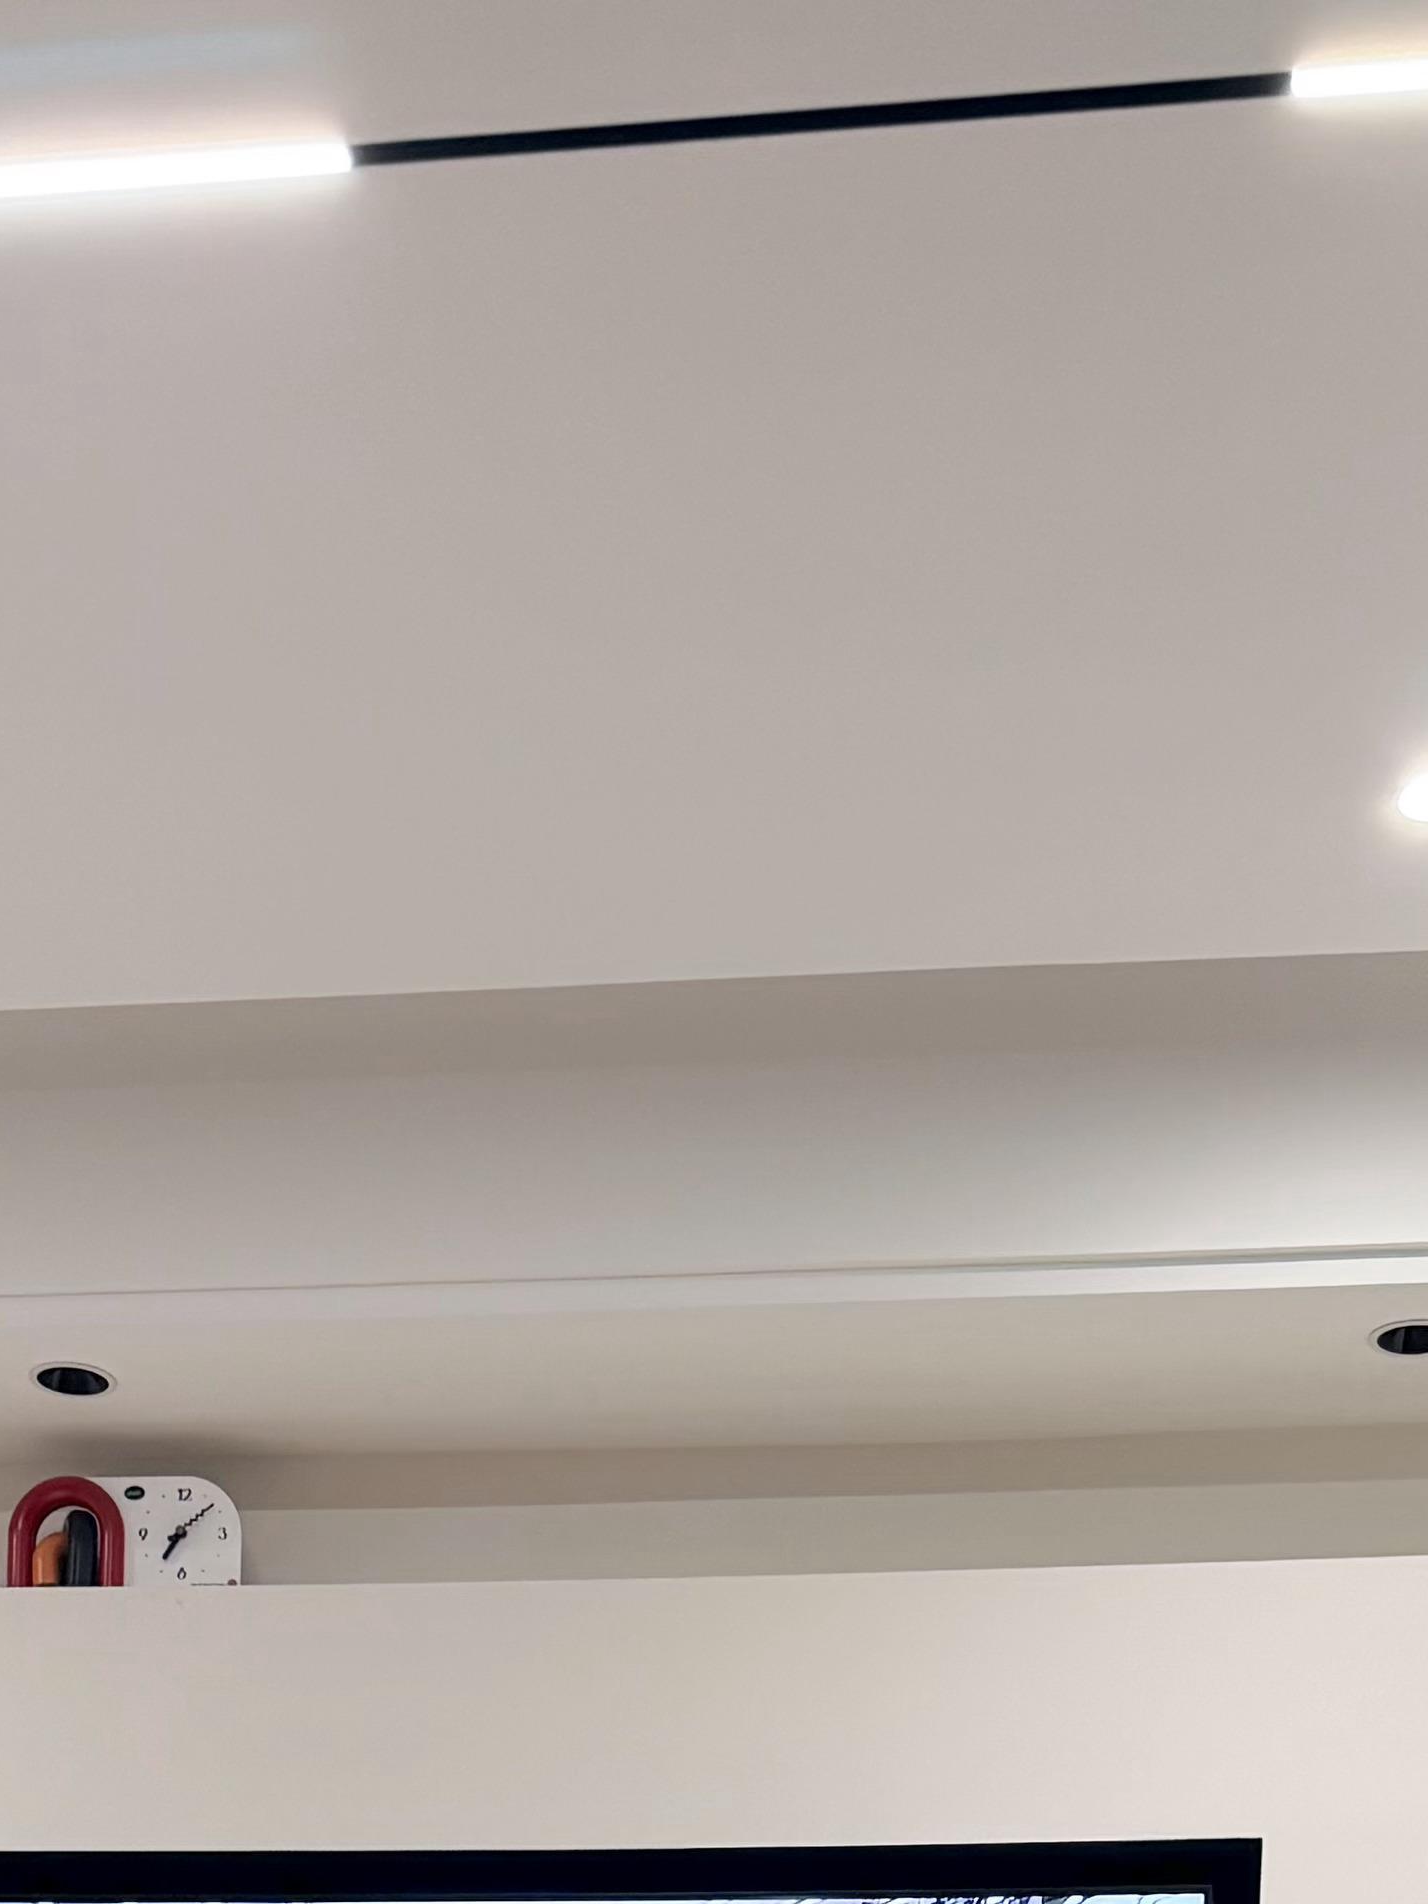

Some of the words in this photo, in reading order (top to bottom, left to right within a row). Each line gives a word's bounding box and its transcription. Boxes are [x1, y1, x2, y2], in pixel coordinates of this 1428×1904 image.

[178, 1487, 192, 1501] 12
[138, 1527, 148, 1541] 9
[217, 1526, 228, 1541] 3
[177, 1566, 187, 1580] 6
